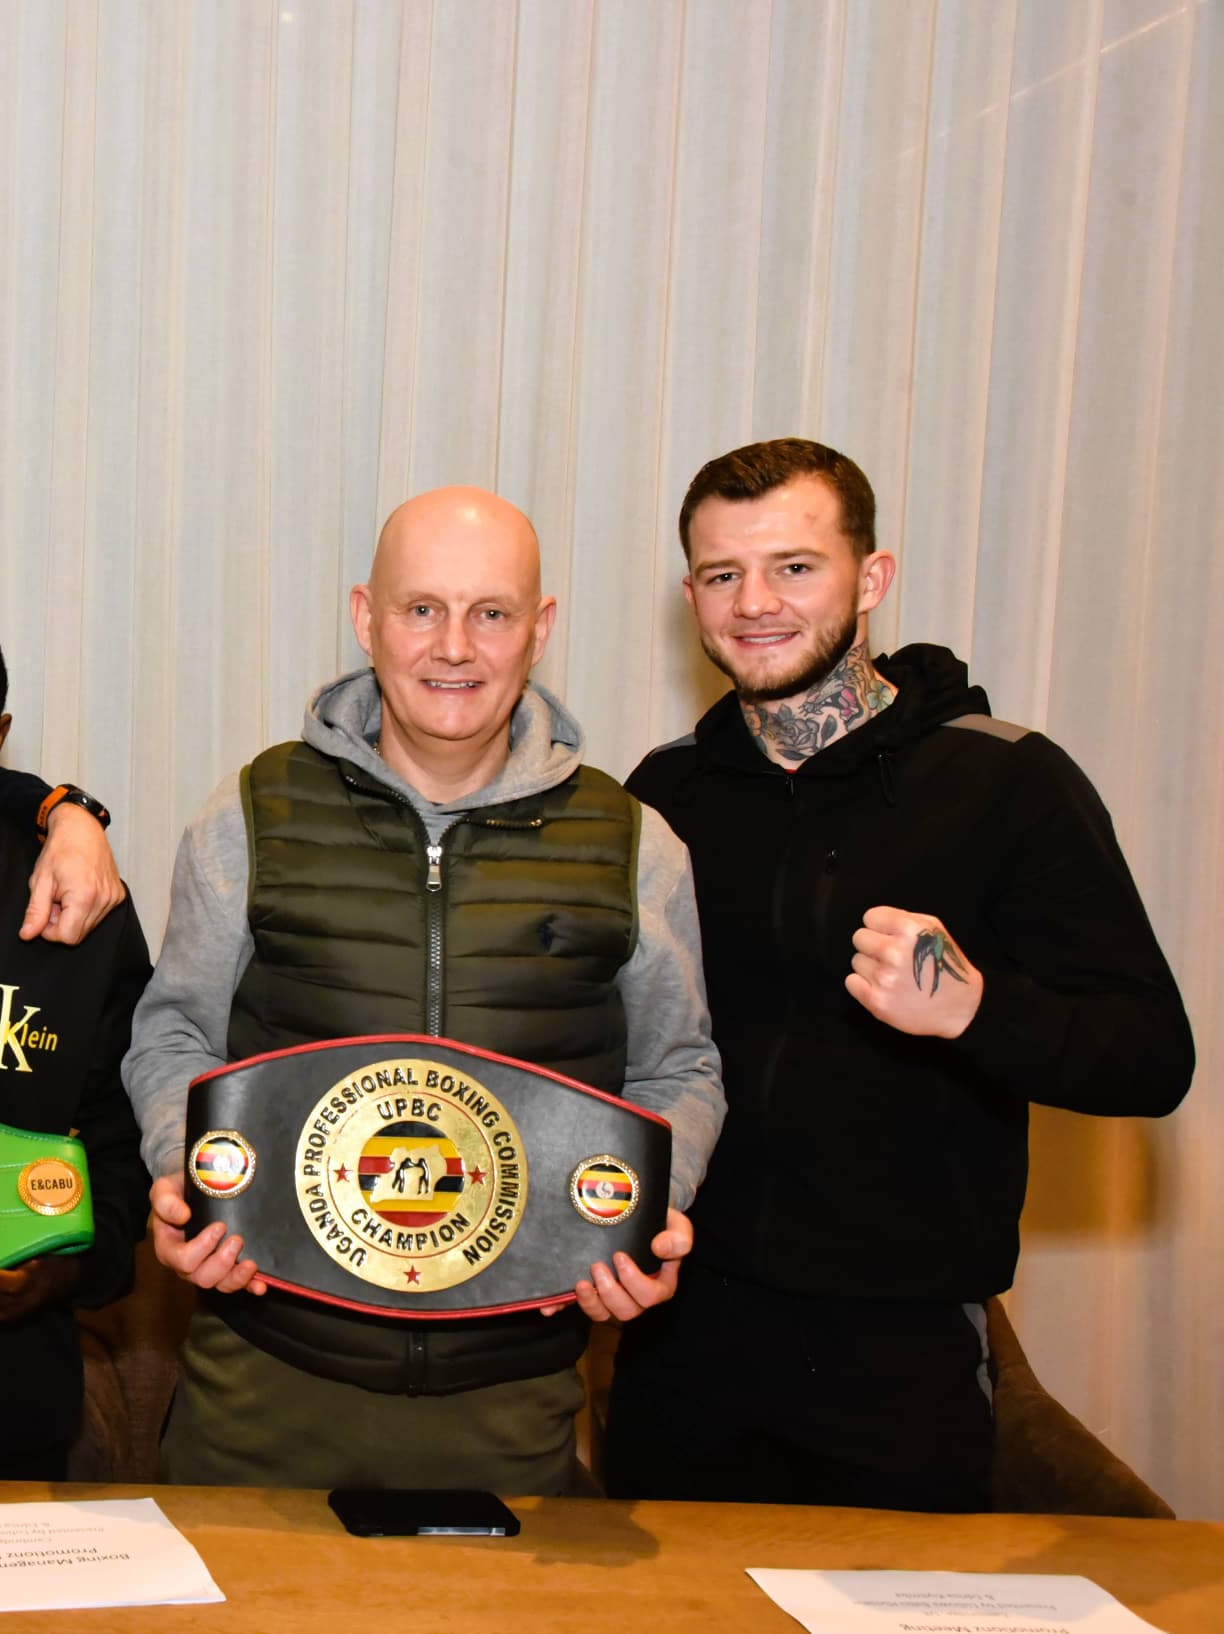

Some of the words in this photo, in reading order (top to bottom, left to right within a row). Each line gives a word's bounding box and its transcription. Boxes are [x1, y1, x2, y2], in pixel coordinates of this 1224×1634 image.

[377, 1098, 442, 1121] UPBC
[426, 1069, 501, 1128] BOXING
[303, 1068, 419, 1176] PROFESSIONAL
[31, 1178, 73, 1190] E&CABU
[462, 1131, 520, 1267] COMMISSION
[305, 1184, 367, 1267] UGANDA
[351, 1208, 471, 1251] CHAMPION
[7, 1547, 98, 1559] Promotionz
[77, 1553, 130, 1563] Boxing
